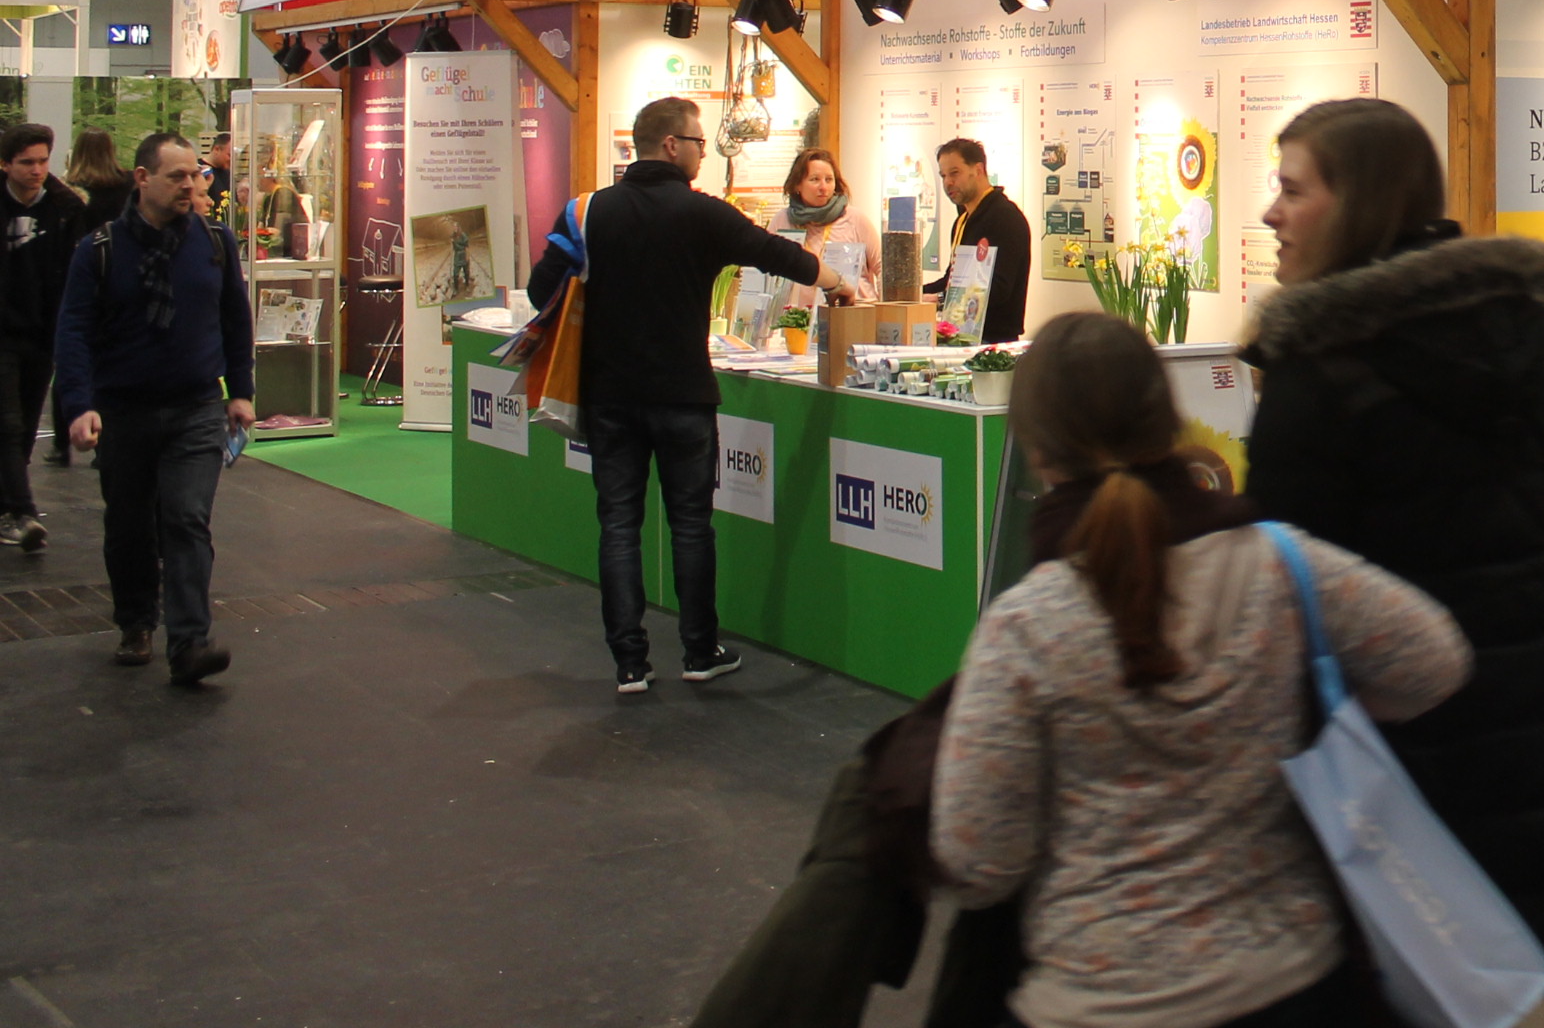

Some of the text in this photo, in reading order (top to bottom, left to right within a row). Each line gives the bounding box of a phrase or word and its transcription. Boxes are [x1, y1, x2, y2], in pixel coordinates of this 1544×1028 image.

[880, 18, 1086, 47] Nachwachsende Rohstoffe Stoffe der Zukunft
[1201, 13, 1338, 30] Landesbetrieb Landwirtschaft Hessen
[1201, 29, 1338, 46] Kompetenzzentrum HessenRohstoffe (HeRo)
[880, 44, 1076, 65] Unterrichtsmaterial Workshops Fortbildungen
[689, 65, 712, 76] EIN
[519, 78, 545, 108] hule
[424, 367, 447, 376] Gefgel
[472, 396, 492, 423] LLH
[497, 396, 520, 417] HERO
[727, 448, 762, 476] HERO
[838, 483, 873, 521] LLH
[884, 484, 927, 516] HERO
